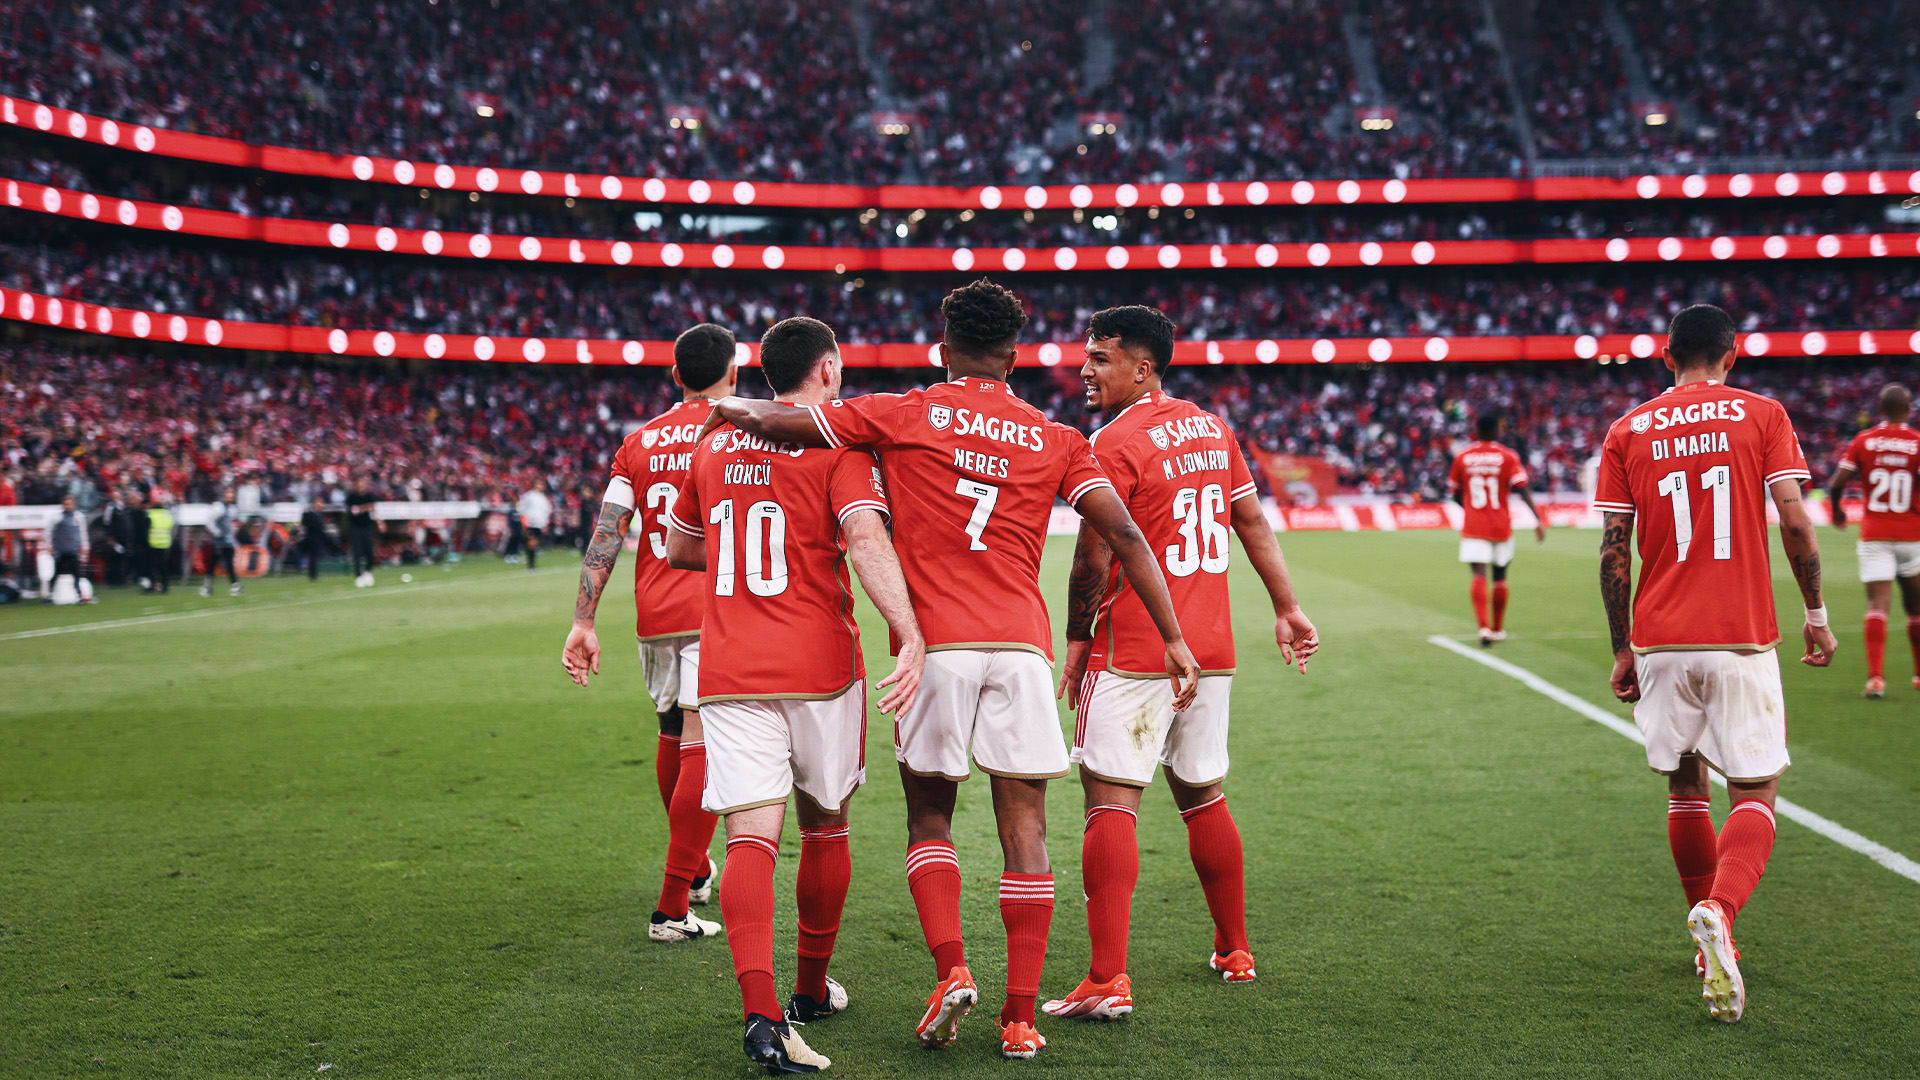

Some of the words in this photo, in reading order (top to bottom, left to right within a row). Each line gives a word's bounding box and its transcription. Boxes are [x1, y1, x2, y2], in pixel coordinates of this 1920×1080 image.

[979, 382, 995, 390] 120
[953, 408, 1045, 452] SAGRES
[1165, 415, 1222, 447] SAGRES
[1654, 399, 1746, 431] SAGRES
[953, 447, 1010, 479] NERES
[1652, 439, 1669, 461] DI
[1674, 432, 1730, 458] MARIA
[1162, 458, 1177, 481] M.
[1868, 467, 1913, 514] 20
[955, 477, 999, 551] 7
[1165, 483, 1230, 578] 36
[1657, 465, 1732, 562] 11
[709, 498, 789, 598] 10
